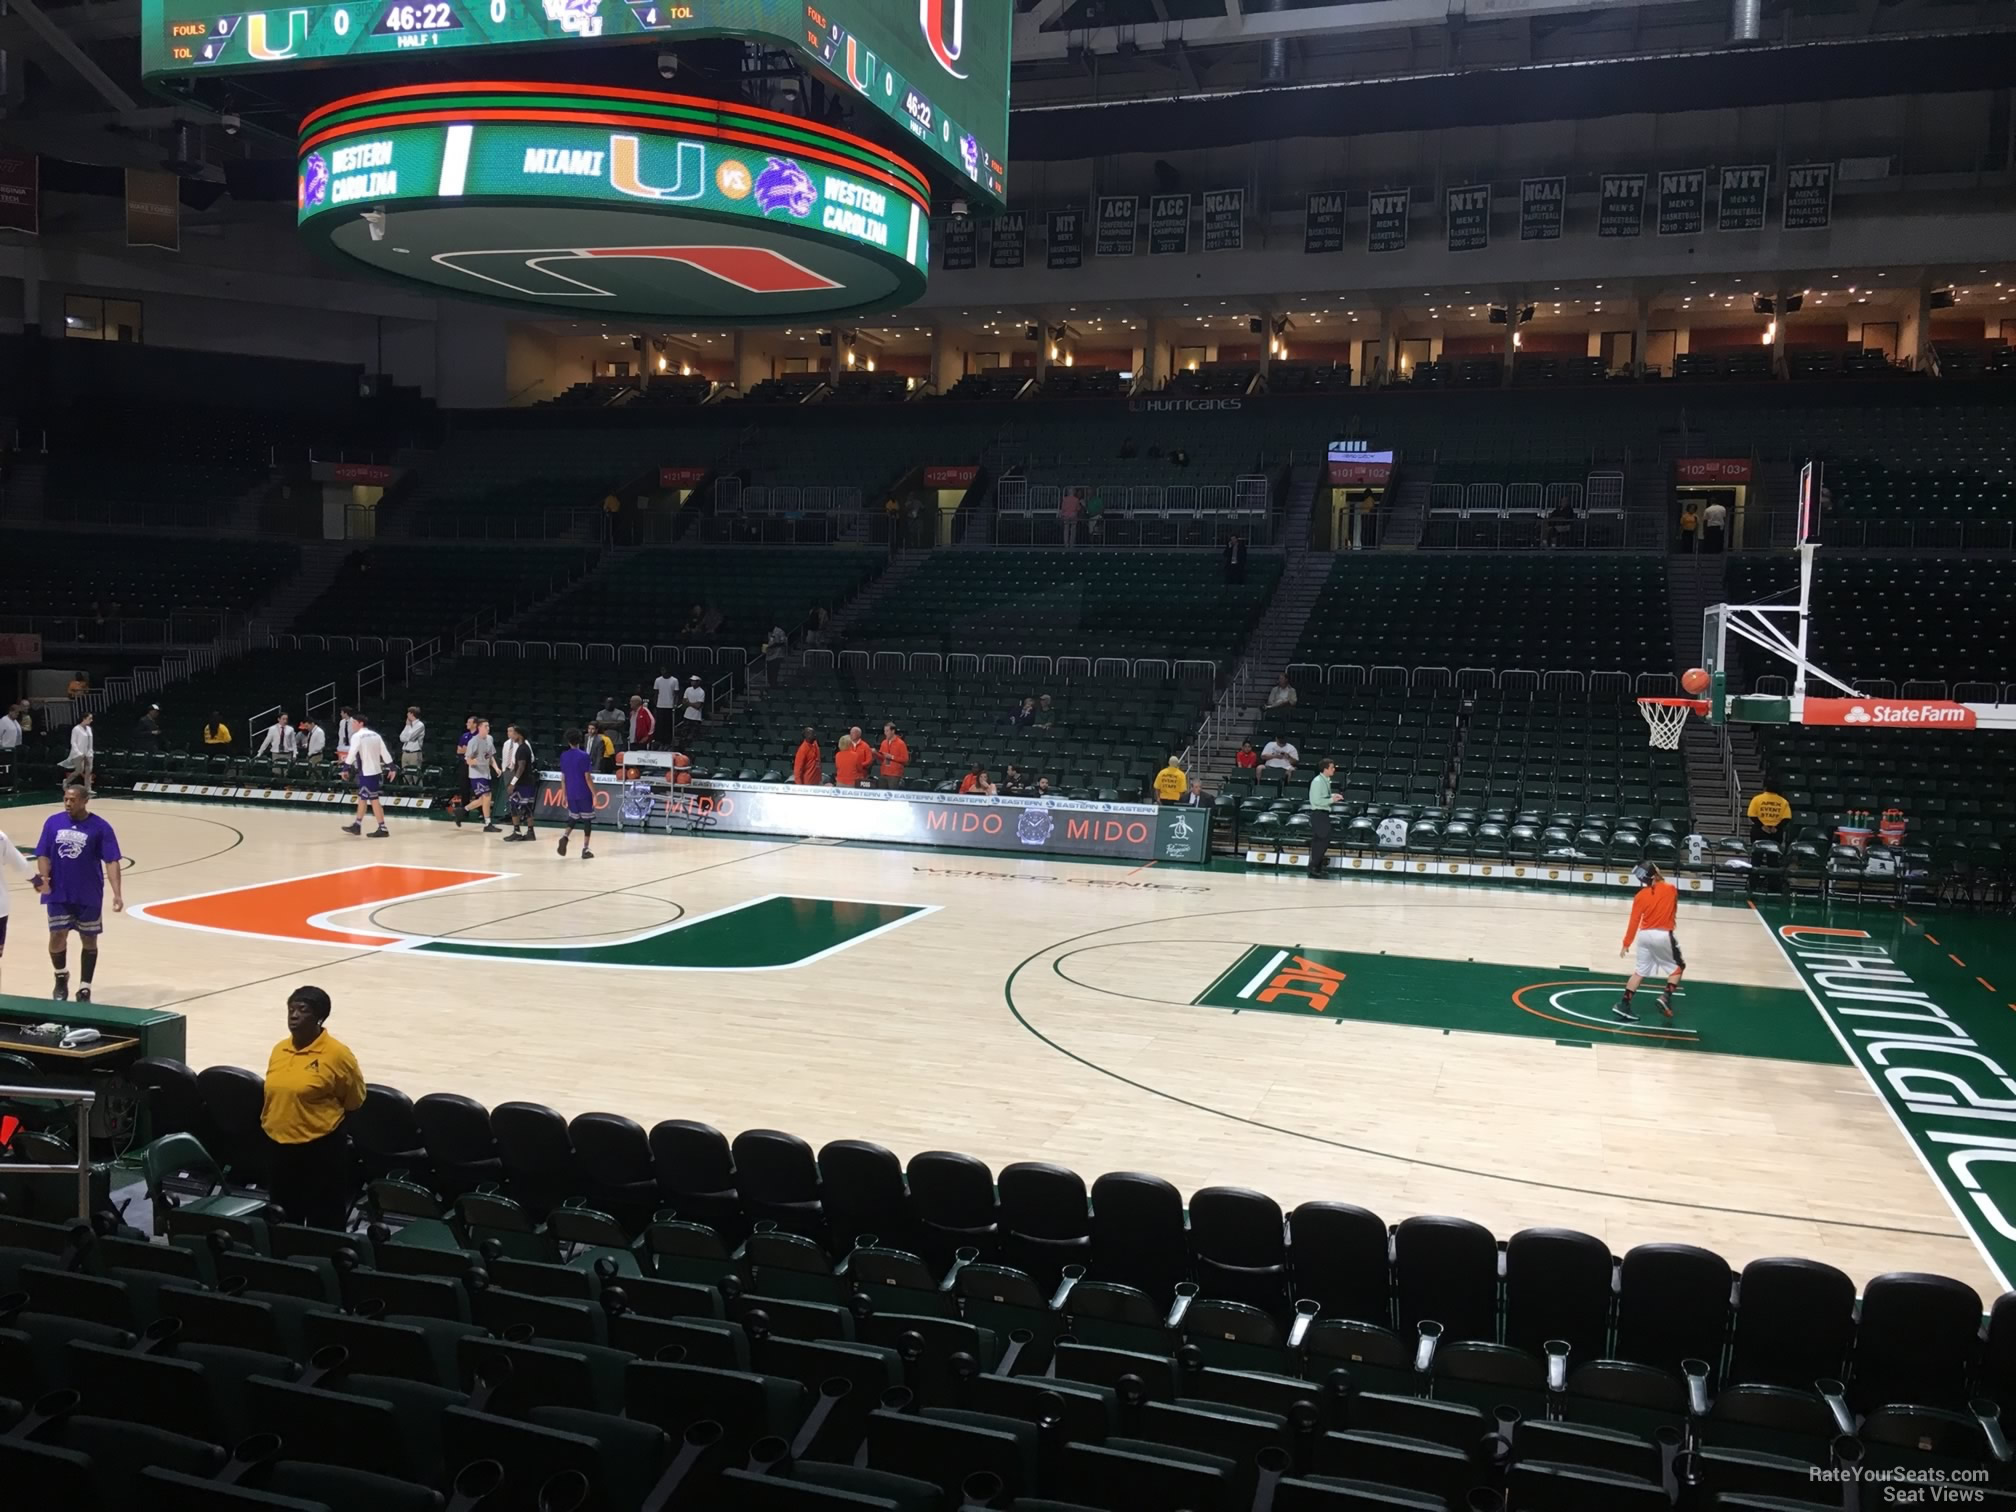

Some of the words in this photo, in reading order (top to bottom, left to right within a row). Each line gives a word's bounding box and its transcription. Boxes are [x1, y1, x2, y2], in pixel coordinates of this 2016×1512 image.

[386, 3, 451, 31] 46:22
[490, 0, 506, 23] 0
[645, 8, 655, 24] 4
[671, 7, 692, 19] TOL
[807, 6, 826, 28] FOULS
[173, 24, 205, 37] FOULS
[218, 19, 228, 35] 0
[334, 9, 349, 36] 0
[397, 35, 428, 48] HALF
[431, 34, 438, 46] 1
[807, 30, 818, 48] TOL
[832, 24, 838, 40] 0
[174, 48, 192, 59] TOL
[203, 44, 213, 60] 4
[824, 44, 830, 60] 4
[885, 71, 893, 96] 0
[905, 91, 931, 128] 46:22
[942, 119, 949, 142] 0
[331, 141, 394, 175] WESTERN
[523, 148, 604, 177] MIAMI
[331, 170, 398, 204] CAROLINA
[1663, 174, 1702, 194] NIT
[1724, 170, 1764, 189] NIT
[1789, 169, 1829, 189] NIT
[824, 175, 887, 218] WESTERN
[1524, 183, 1561, 201] NCAA
[1604, 180, 1643, 198] NIT
[1105, 201, 1132, 218] ACC
[1157, 199, 1184, 217] ACC
[1206, 194, 1241, 213] NCAA
[1310, 195, 1343, 214] NCAA
[1372, 196, 1406, 215] NIT
[1451, 191, 1486, 212] NIT
[1668, 200, 1694, 208] MEN'S
[822, 205, 888, 247] CAROLINA
[993, 215, 1024, 232] NCAA
[1056, 216, 1076, 232] NIT
[342, 469, 357, 477] 120
[369, 471, 383, 479] 121
[669, 473, 680, 481] 121
[933, 472, 947, 481] 122
[960, 472, 973, 480] 101
[1338, 469, 1353, 478] 101
[1369, 469, 1385, 478] 102
[1687, 464, 1705, 475] 102
[1722, 464, 1741, 475] 103
[741, 783, 780, 792] EASTERN
[842, 788, 881, 797] EASTERN
[894, 793, 934, 801] EASTERN
[947, 796, 988, 804] EASTERN
[1001, 798, 1042, 807] EASTERN
[1057, 801, 1098, 810] EASTERN
[1113, 806, 1156, 814] EASTERN
[1760, 806, 1781, 814] EVENT
[926, 810, 1003, 834] MIDO
[1067, 819, 1149, 843] MIDO
[1257, 956, 1346, 1012] ACC
